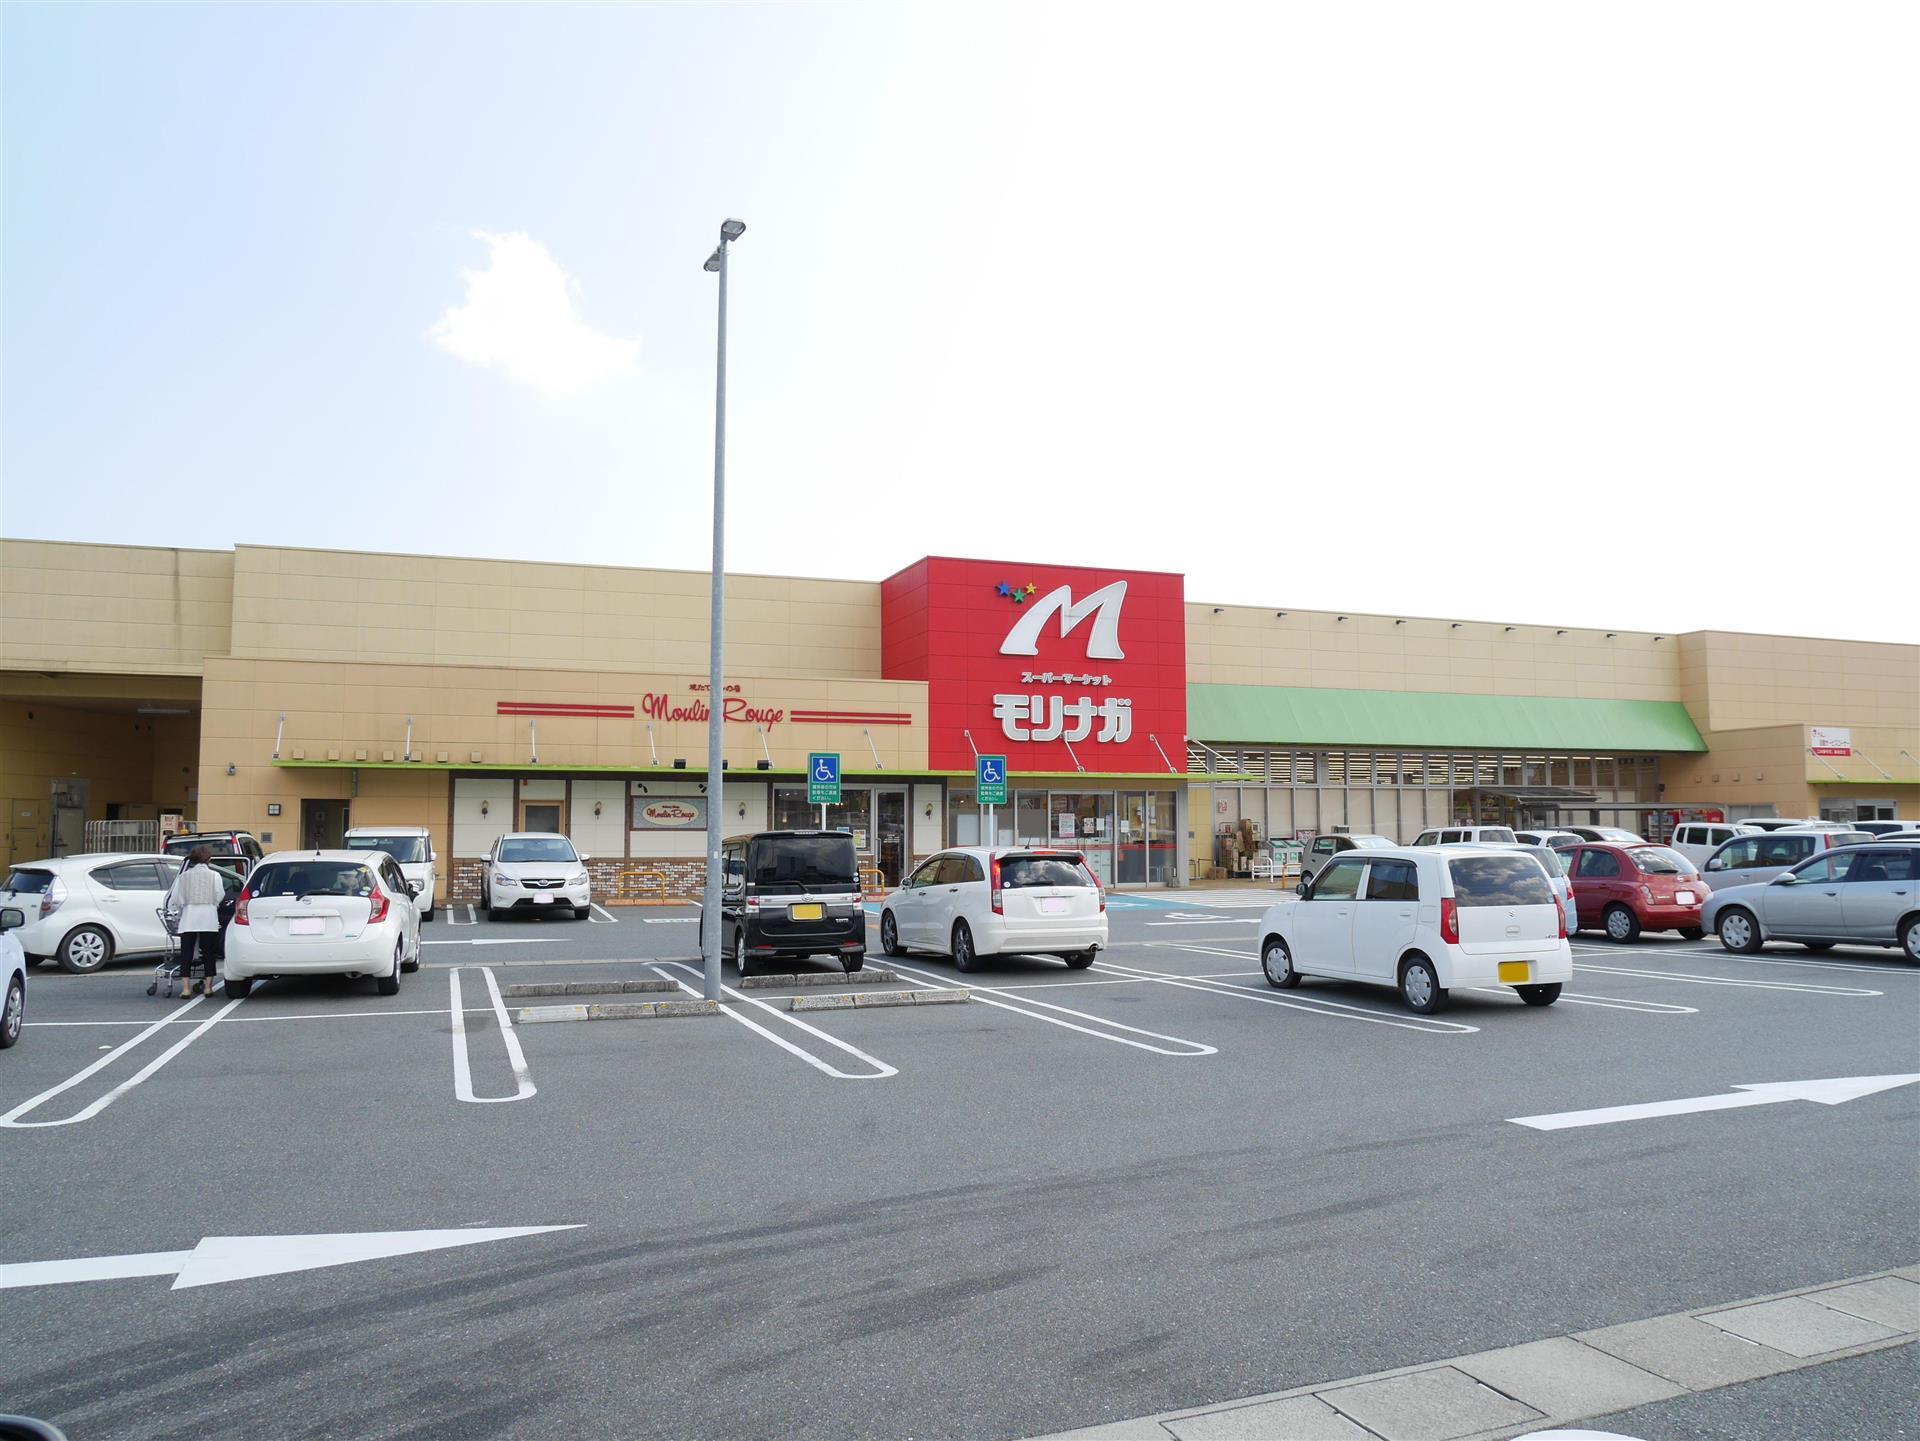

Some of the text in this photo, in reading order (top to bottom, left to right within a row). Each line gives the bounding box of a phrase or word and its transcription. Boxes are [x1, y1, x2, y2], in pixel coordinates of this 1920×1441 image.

[999, 580, 1127, 659] M
[1021, 671, 1112, 686] スーパーマーケット
[723, 697, 783, 733] Rouge
[993, 694, 1132, 743] モリナガ
